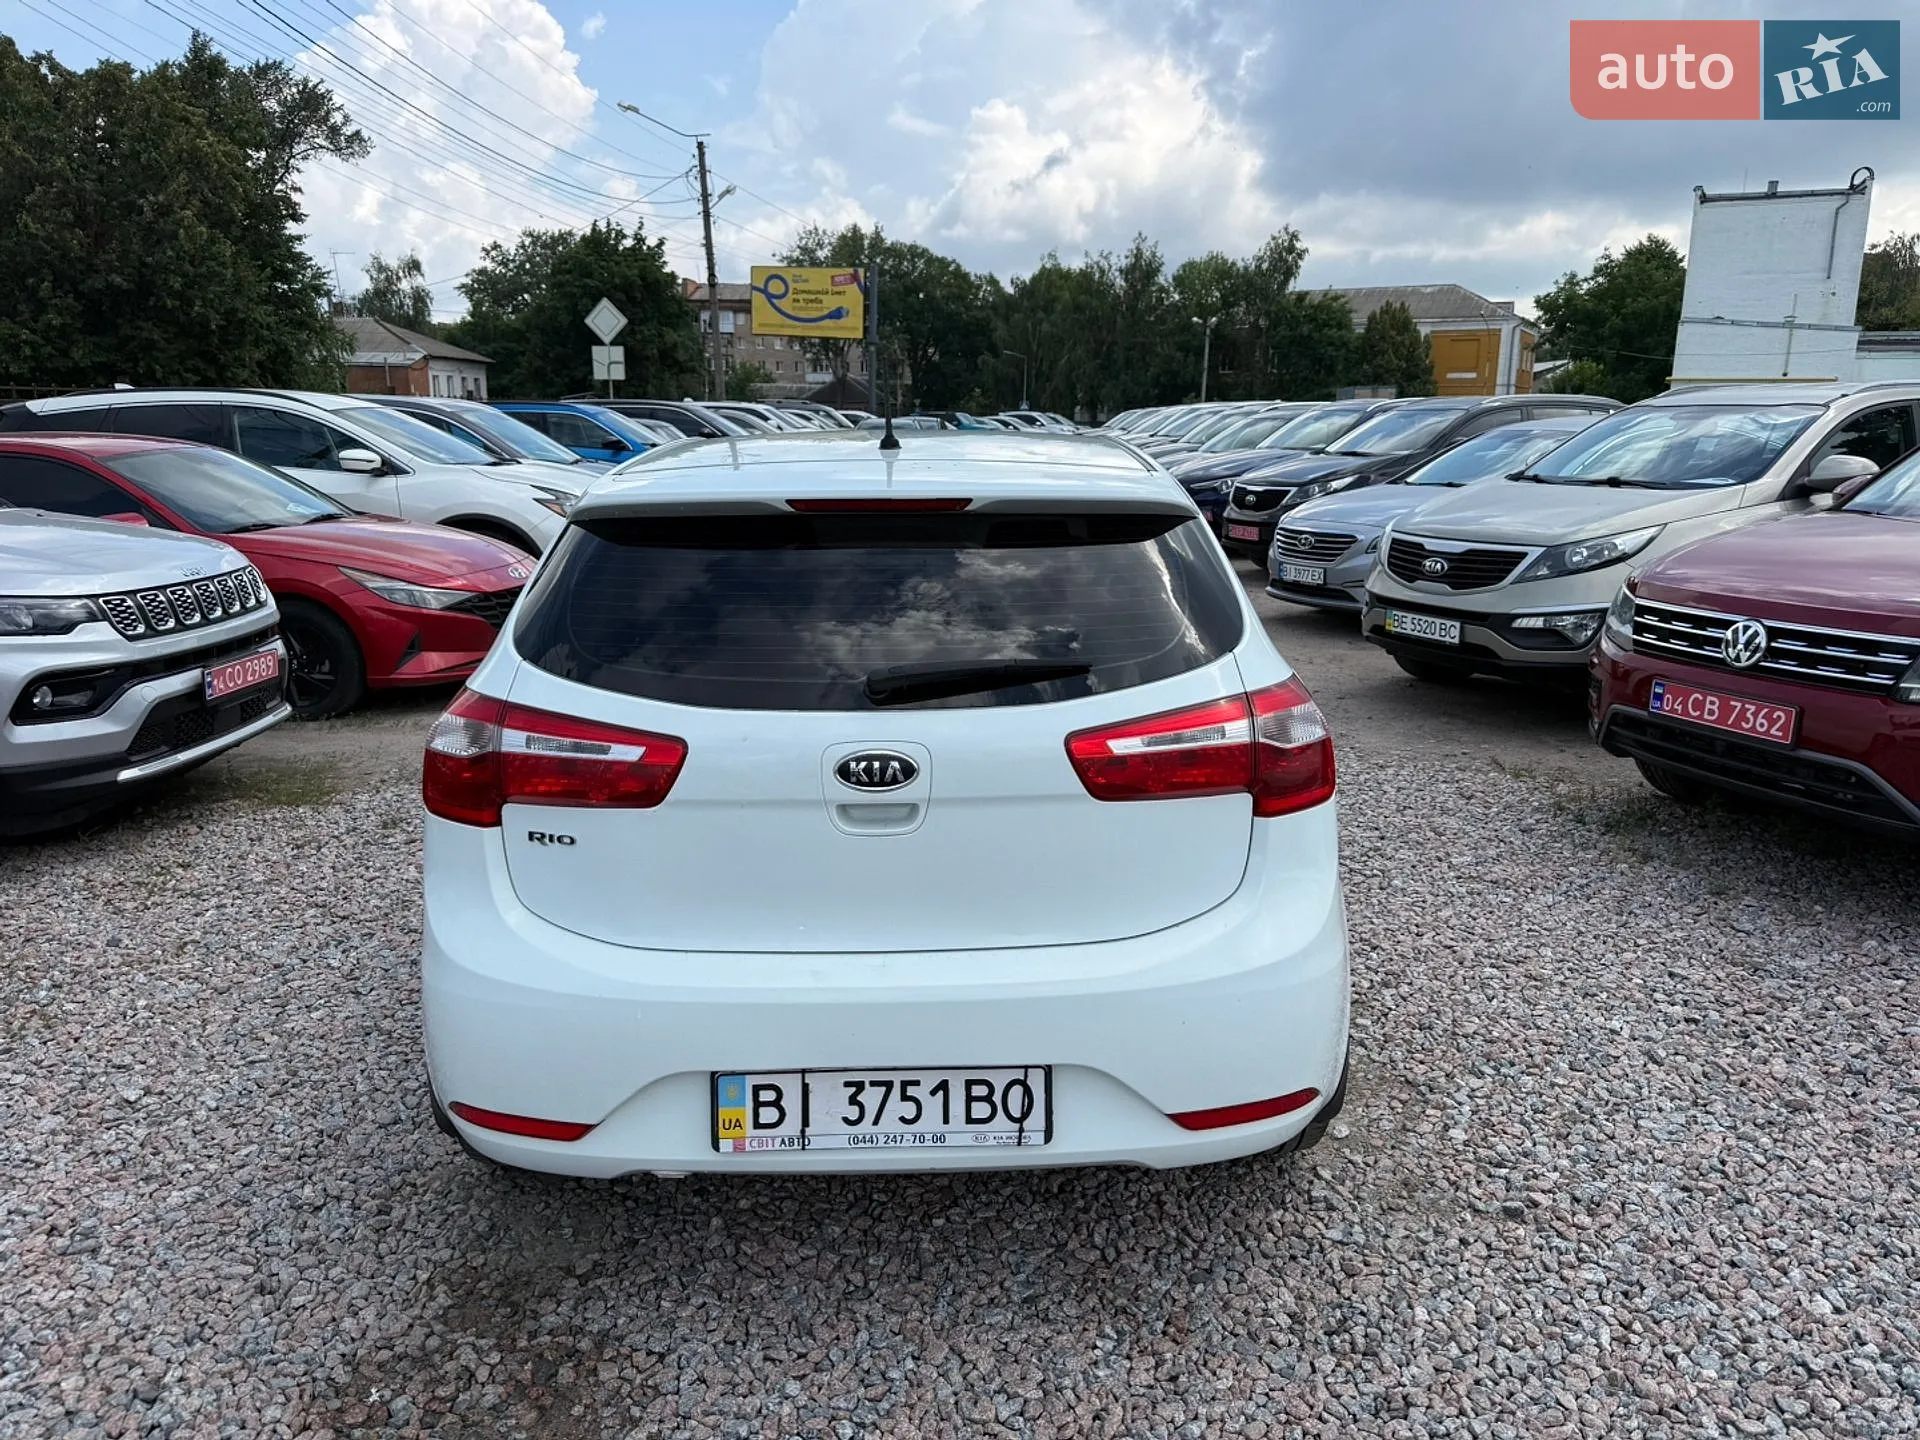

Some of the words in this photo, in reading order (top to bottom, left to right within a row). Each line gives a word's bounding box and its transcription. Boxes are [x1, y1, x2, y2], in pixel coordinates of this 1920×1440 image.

[1393, 613, 1409, 631] BE
[1410, 617, 1437, 636] 5520
[1439, 622, 1458, 640] BC
[245, 655, 274, 681] 2989
[1663, 694, 1684, 715] 04
[1688, 693, 1720, 720] CB
[1727, 701, 1787, 737] 7362
[849, 761, 906, 783] KIA
[527, 830, 577, 846] RIO
[752, 1082, 810, 1130] BI
[722, 1118, 743, 1130] UA
[848, 1134, 879, 1146] (044)
[883, 1133, 947, 1145] 247-70-00
